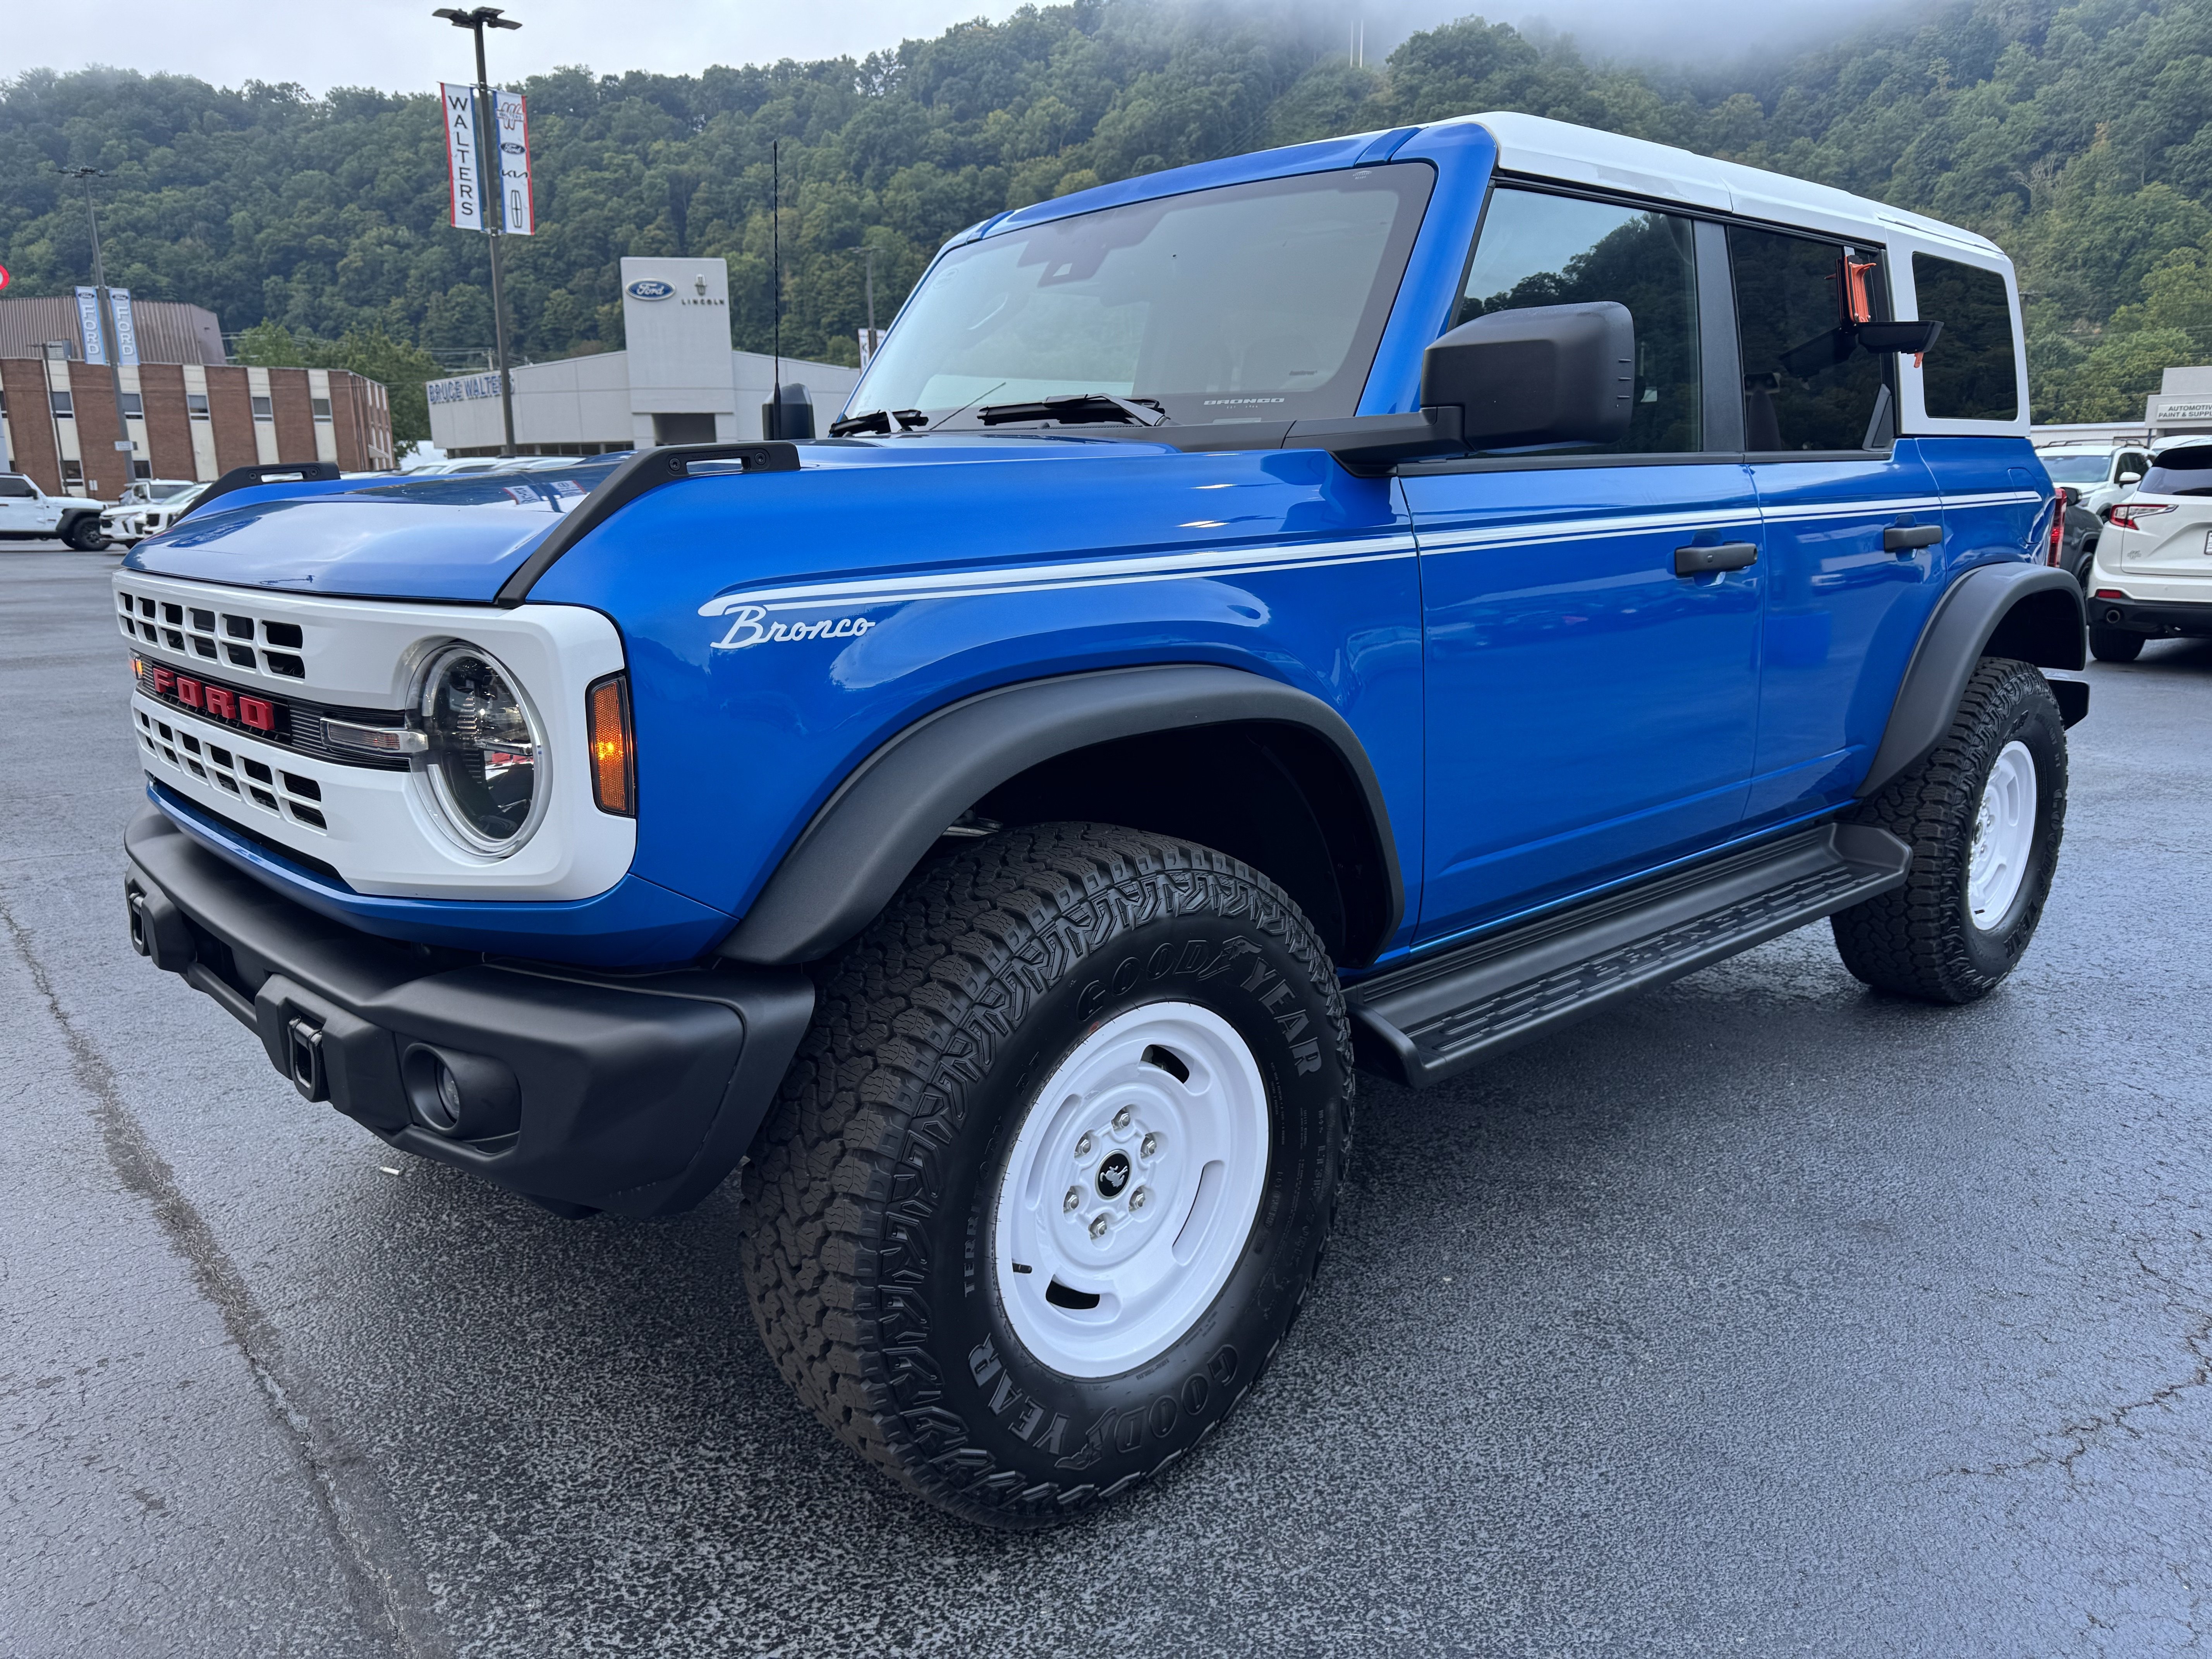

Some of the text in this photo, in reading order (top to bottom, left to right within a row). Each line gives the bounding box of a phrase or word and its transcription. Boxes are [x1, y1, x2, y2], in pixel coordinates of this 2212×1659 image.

[448, 95, 473, 216] WALTERS
[636, 283, 665, 295] Ford
[82, 304, 100, 354] FORD
[116, 306, 134, 355] FORD
[428, 380, 462, 402] BRUCE
[709, 605, 876, 649] Bronco
[153, 667, 275, 731] FORD
[963, 1115, 1005, 1298] TERRITORY
